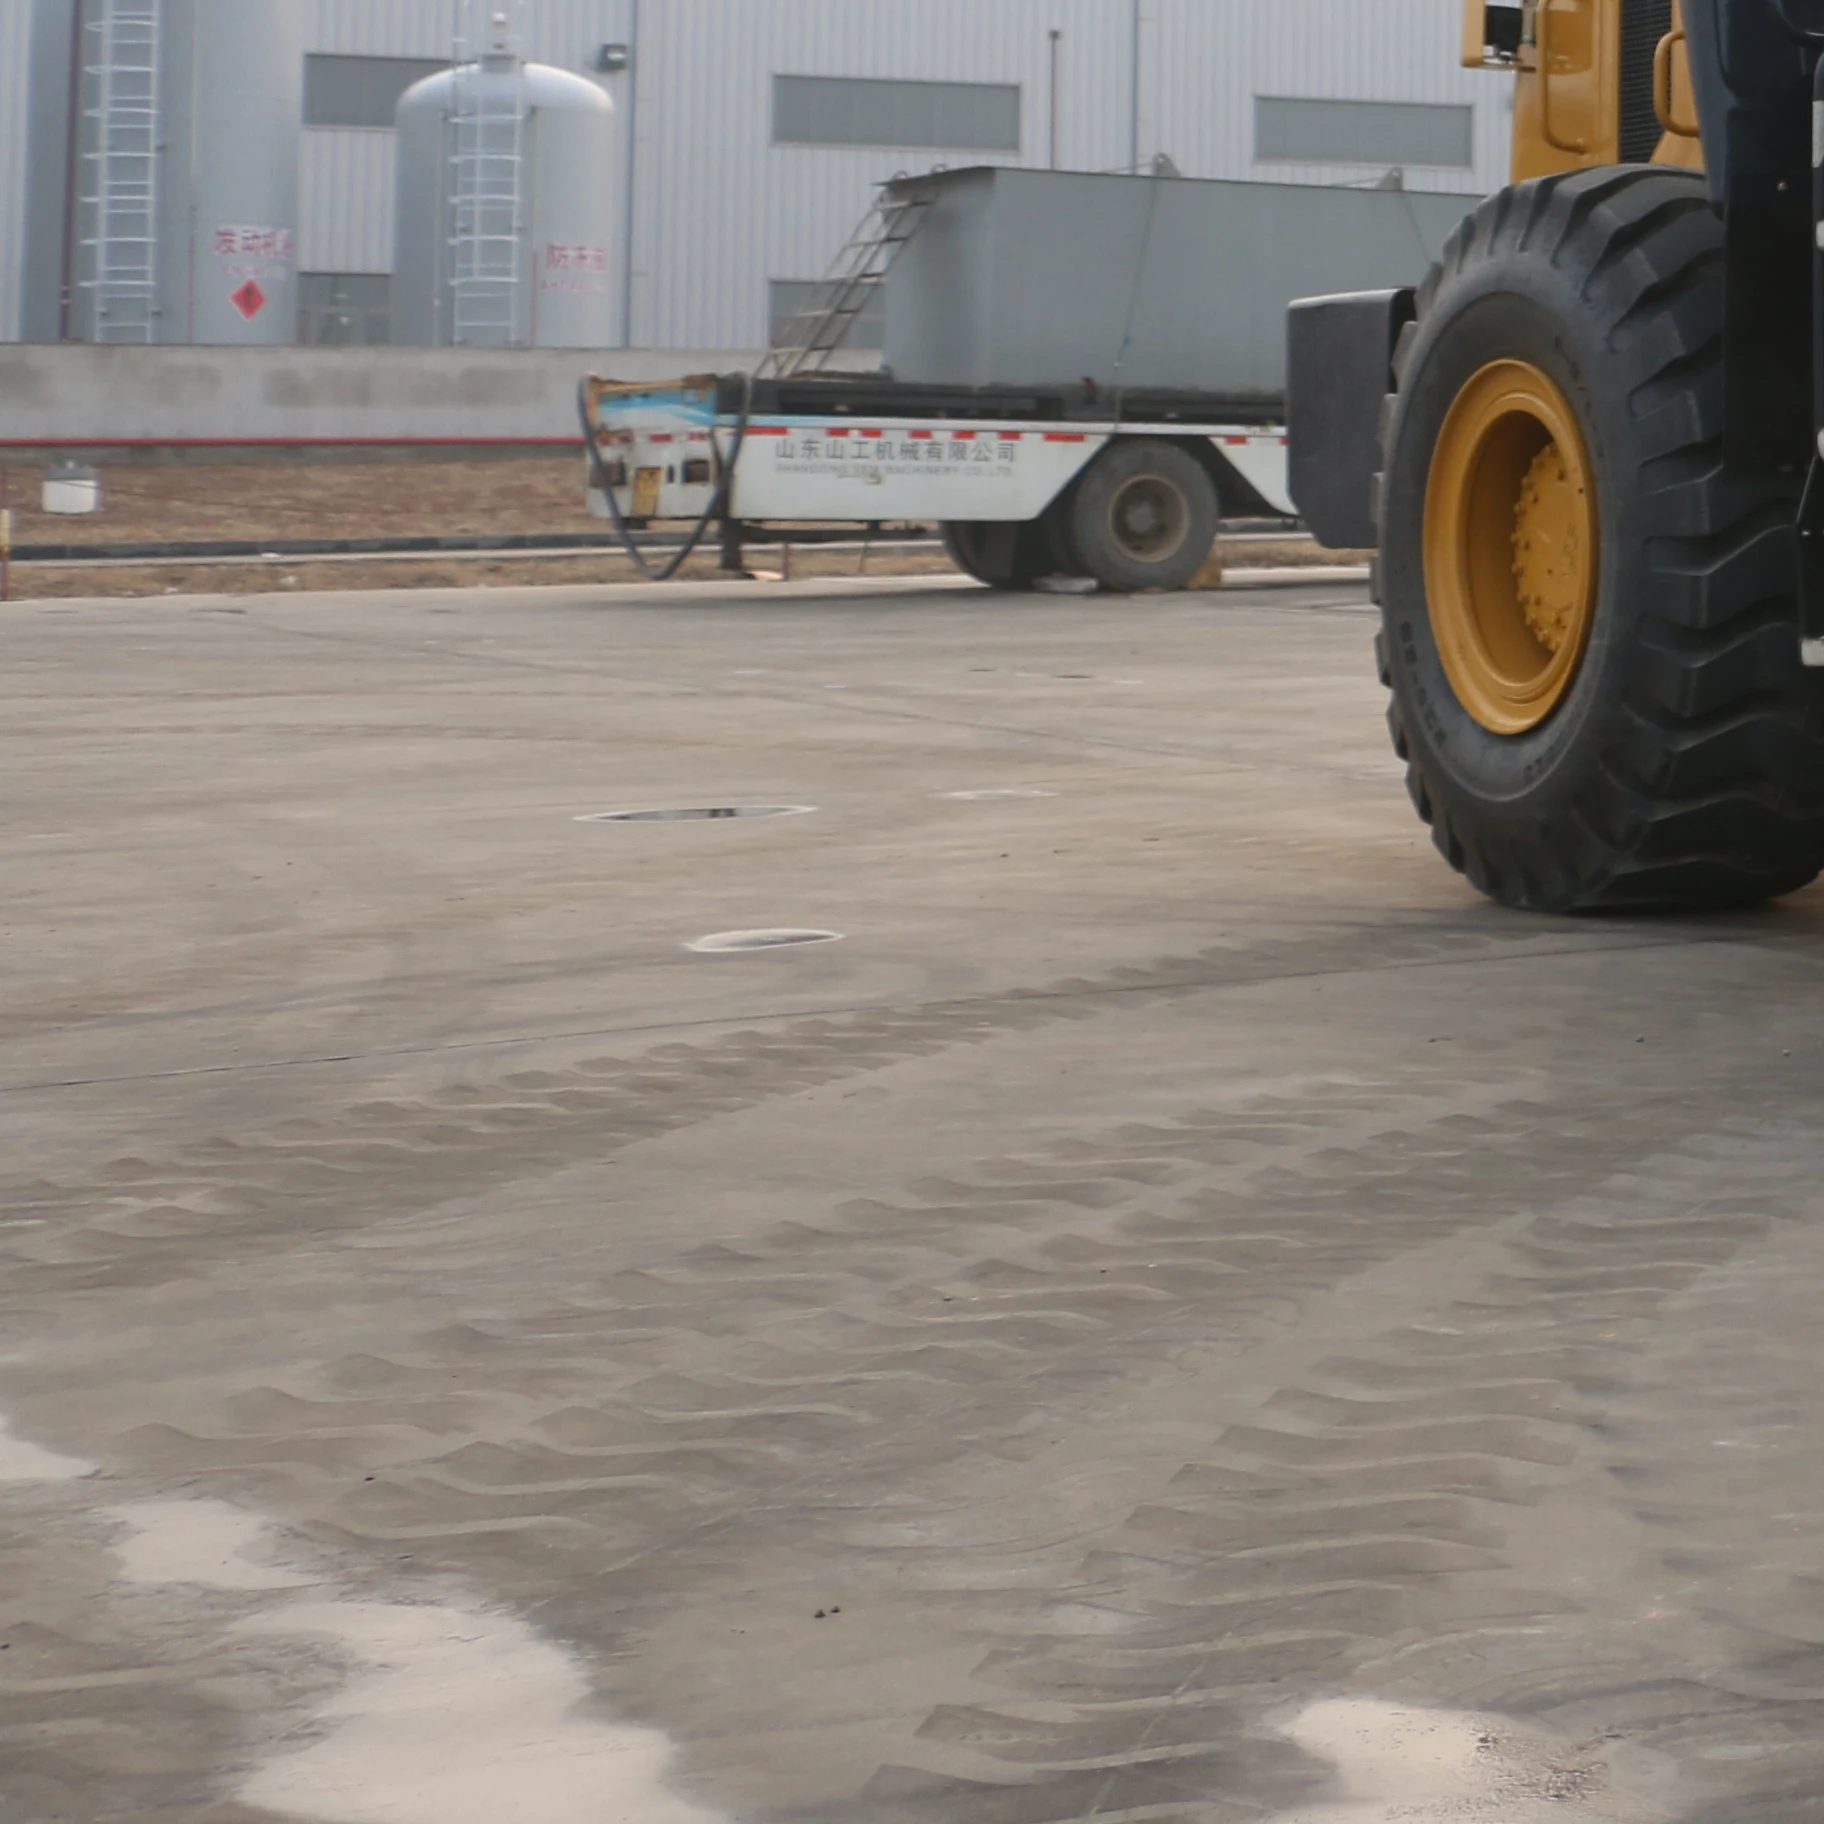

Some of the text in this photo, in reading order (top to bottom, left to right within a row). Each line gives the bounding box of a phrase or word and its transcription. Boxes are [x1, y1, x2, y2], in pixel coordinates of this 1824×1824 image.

[774, 437, 1016, 463] 山东山工机械有限公司
[884, 464, 958, 477] MACHINERY
